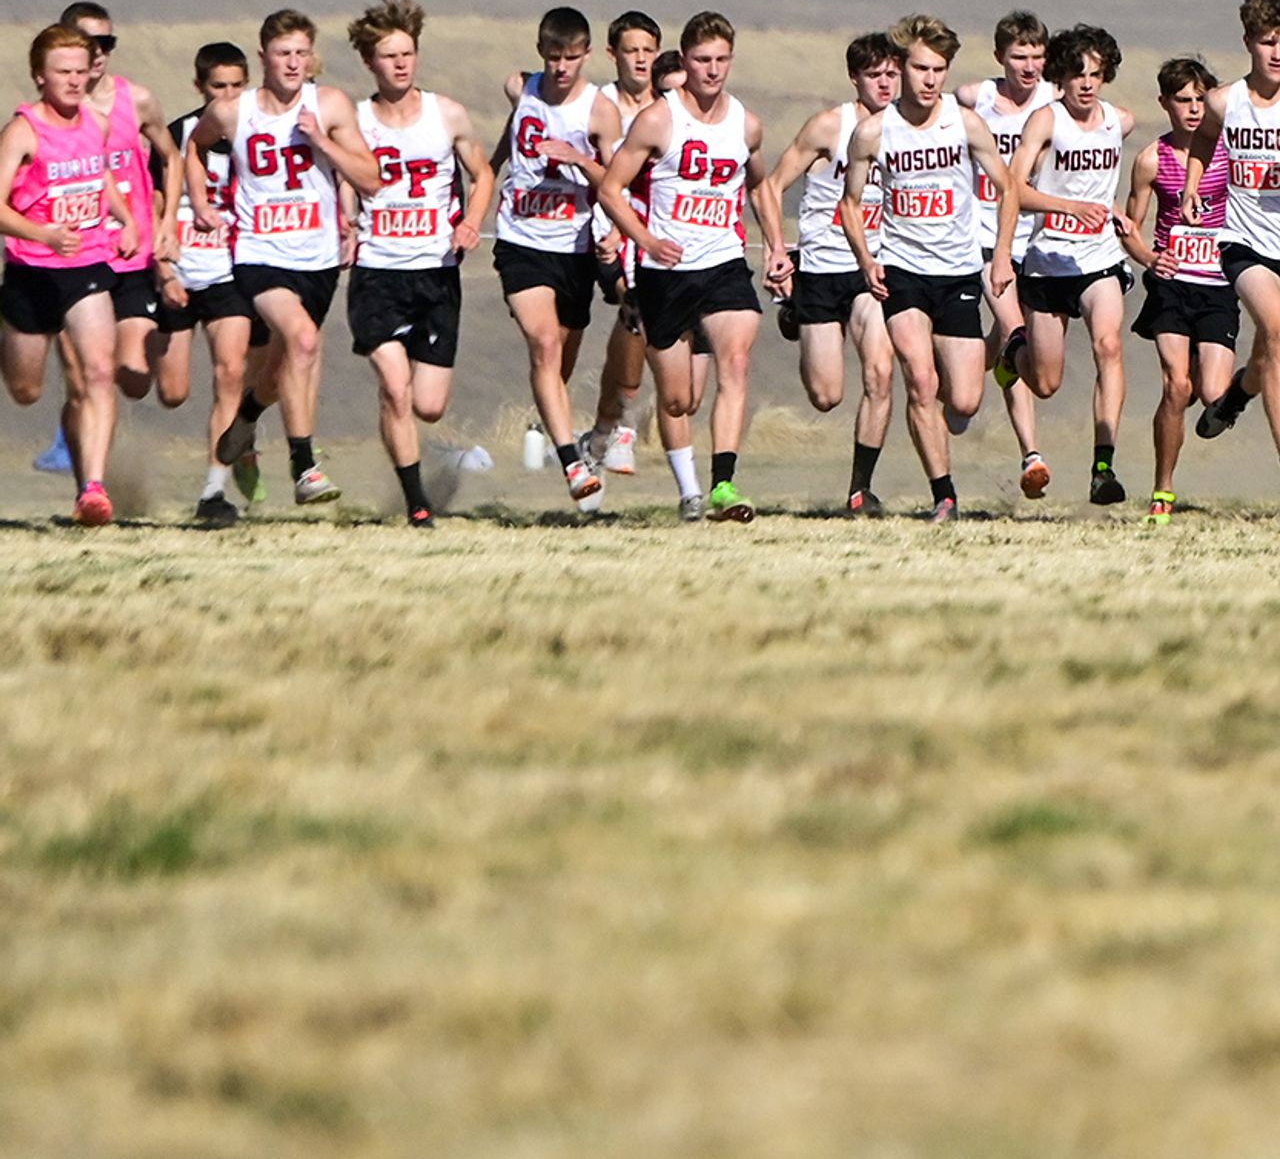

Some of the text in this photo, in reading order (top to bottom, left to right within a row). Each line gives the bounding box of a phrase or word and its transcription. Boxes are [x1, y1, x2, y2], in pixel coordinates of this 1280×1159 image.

[247, 133, 314, 190] GP
[373, 146, 437, 198] GP
[679, 139, 738, 186] GP
[886, 145, 962, 173] MOSCOW
[52, 194, 99, 224] 0326
[517, 192, 568, 219] 0442
[678, 196, 728, 227] 0448
[896, 190, 948, 217] 0573
[259, 205, 312, 233] 0447
[378, 210, 432, 237] 0444
[1050, 212, 1086, 233] 05
